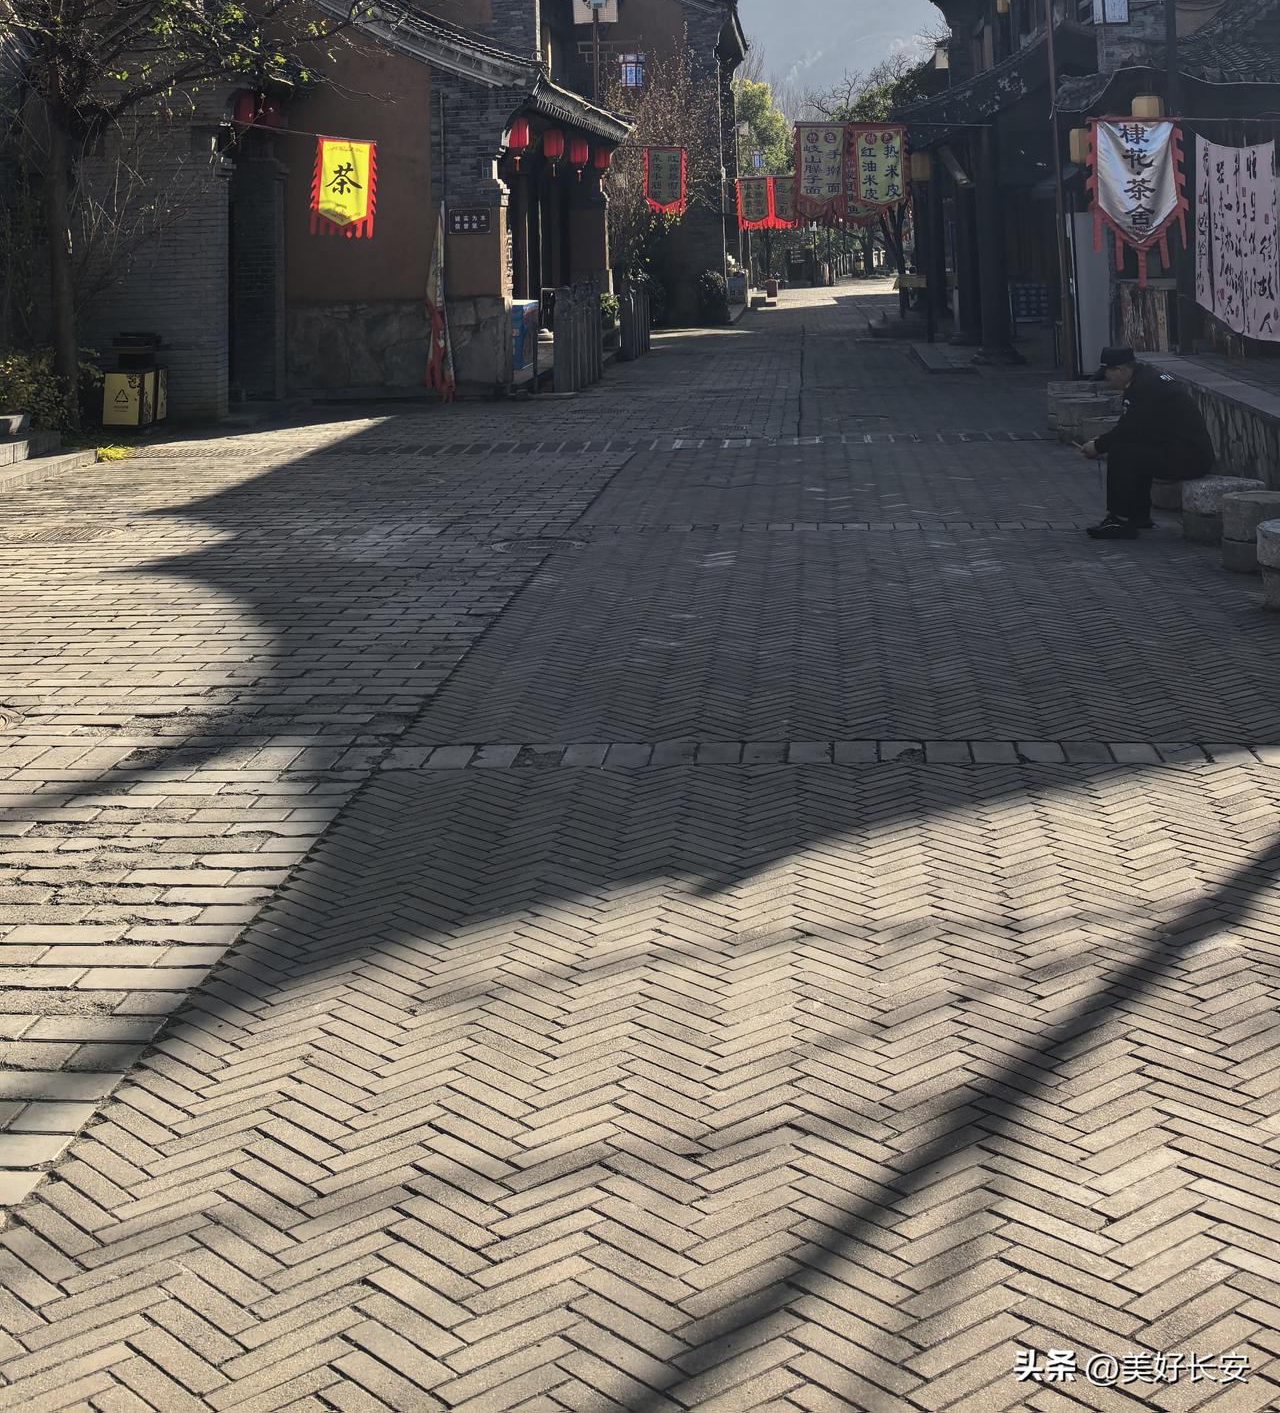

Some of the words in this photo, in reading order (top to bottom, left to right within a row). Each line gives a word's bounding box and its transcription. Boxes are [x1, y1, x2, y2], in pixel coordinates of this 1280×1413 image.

[325, 162, 362, 195] 茶
[861, 147, 879, 200] 红油米皮
[884, 144, 902, 197] 热米皮
